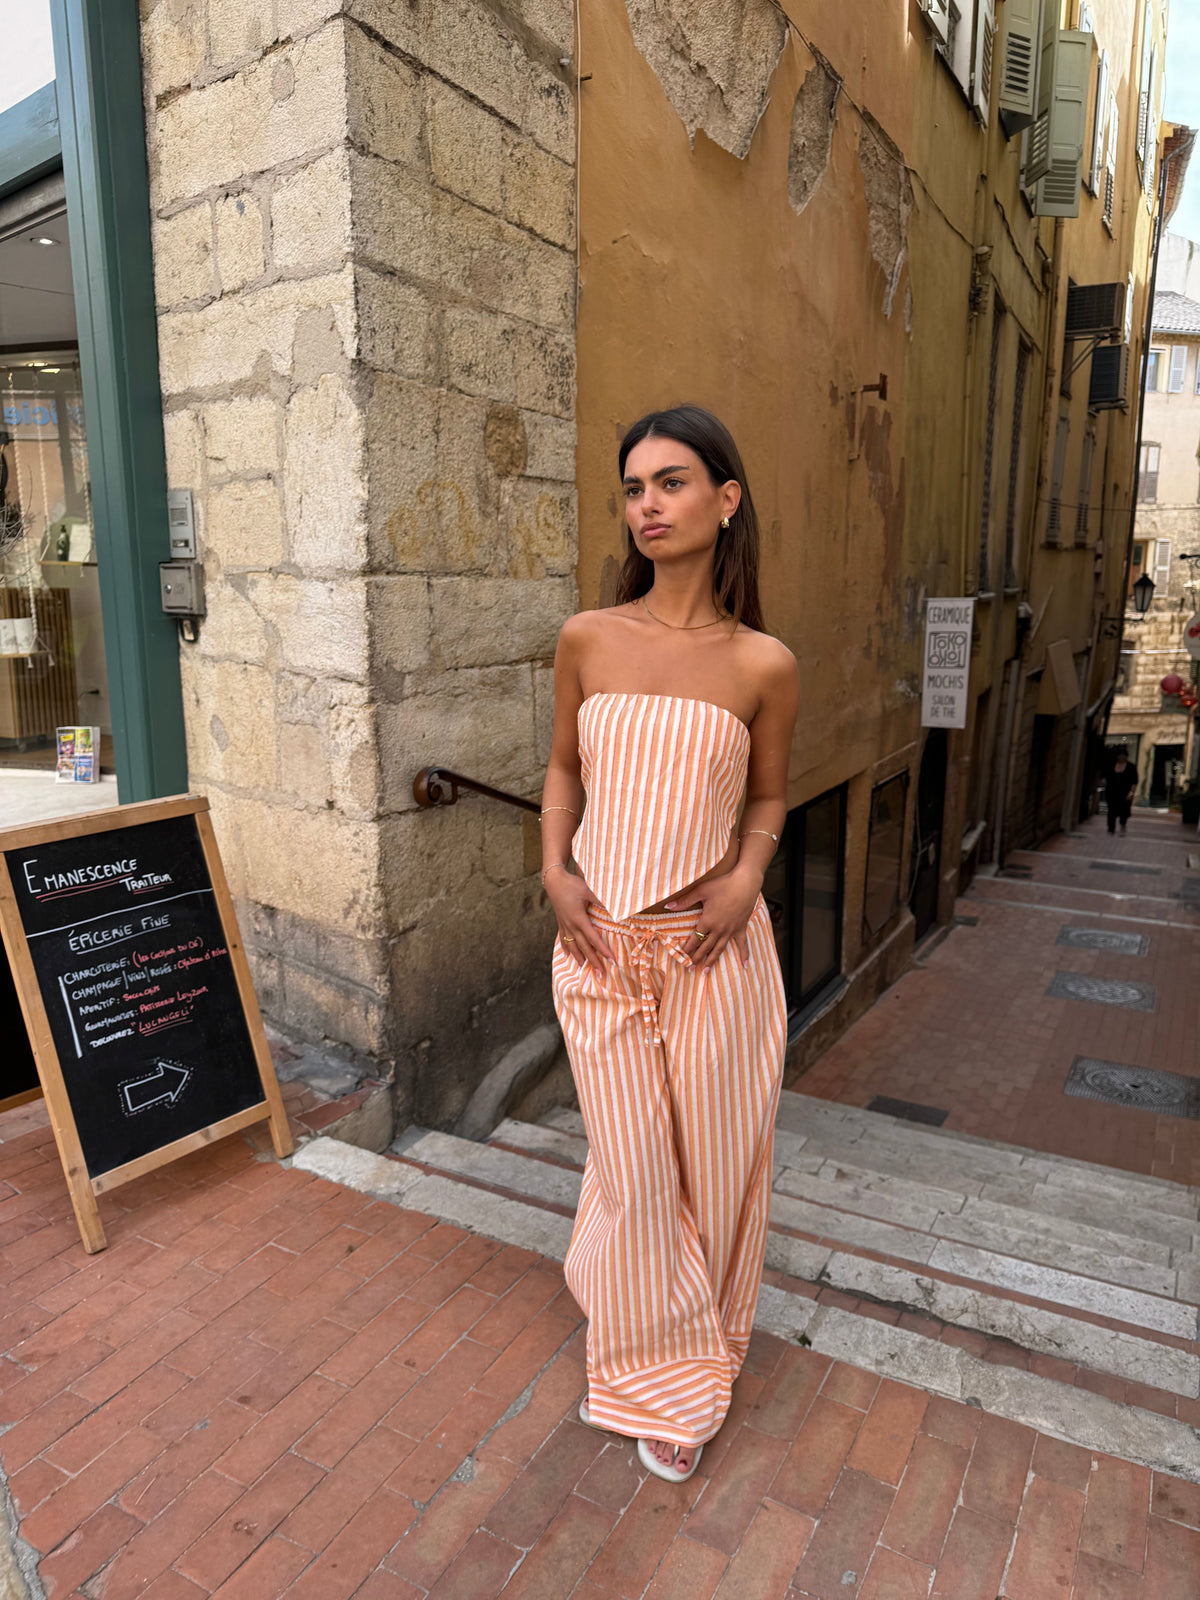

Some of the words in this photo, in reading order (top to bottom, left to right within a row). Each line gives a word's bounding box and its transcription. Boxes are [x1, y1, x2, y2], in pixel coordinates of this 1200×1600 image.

[927, 675, 964, 689] MOCHIS
[932, 695, 955, 706] SALON
[930, 706, 940, 718] DE
[23, 859, 138, 894] EMANESCENCE
[119, 873, 172, 891] TRAITEUR
[68, 924, 133, 951] ÉPICERIE
[141, 914, 170, 930] FINE
